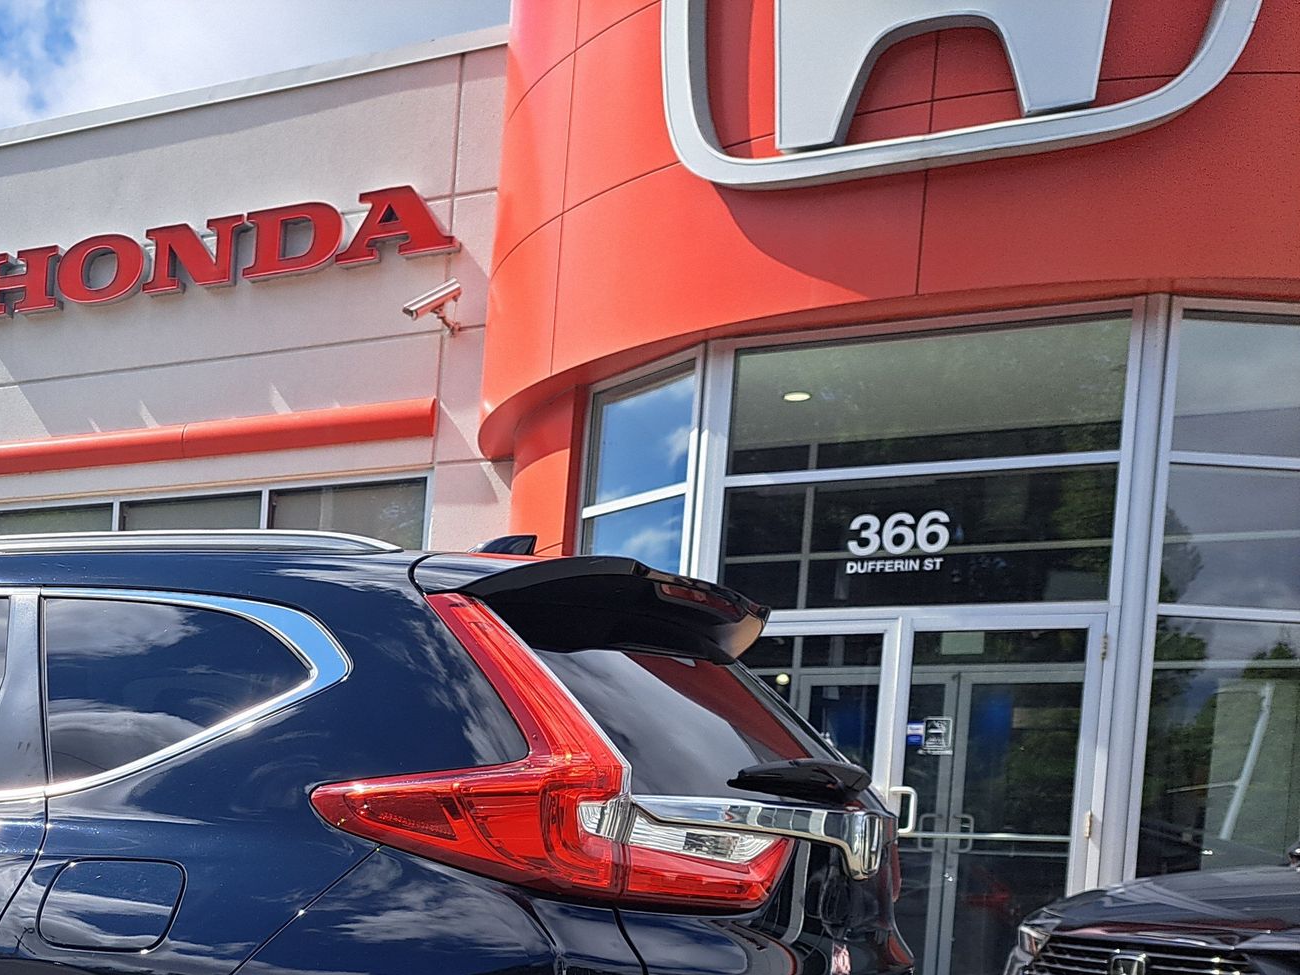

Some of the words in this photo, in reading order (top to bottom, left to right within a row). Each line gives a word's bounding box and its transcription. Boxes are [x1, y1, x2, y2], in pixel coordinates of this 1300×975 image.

[846, 510, 951, 557] 366
[845, 558, 920, 574] DUFFERIN
[923, 557, 944, 571] ST
